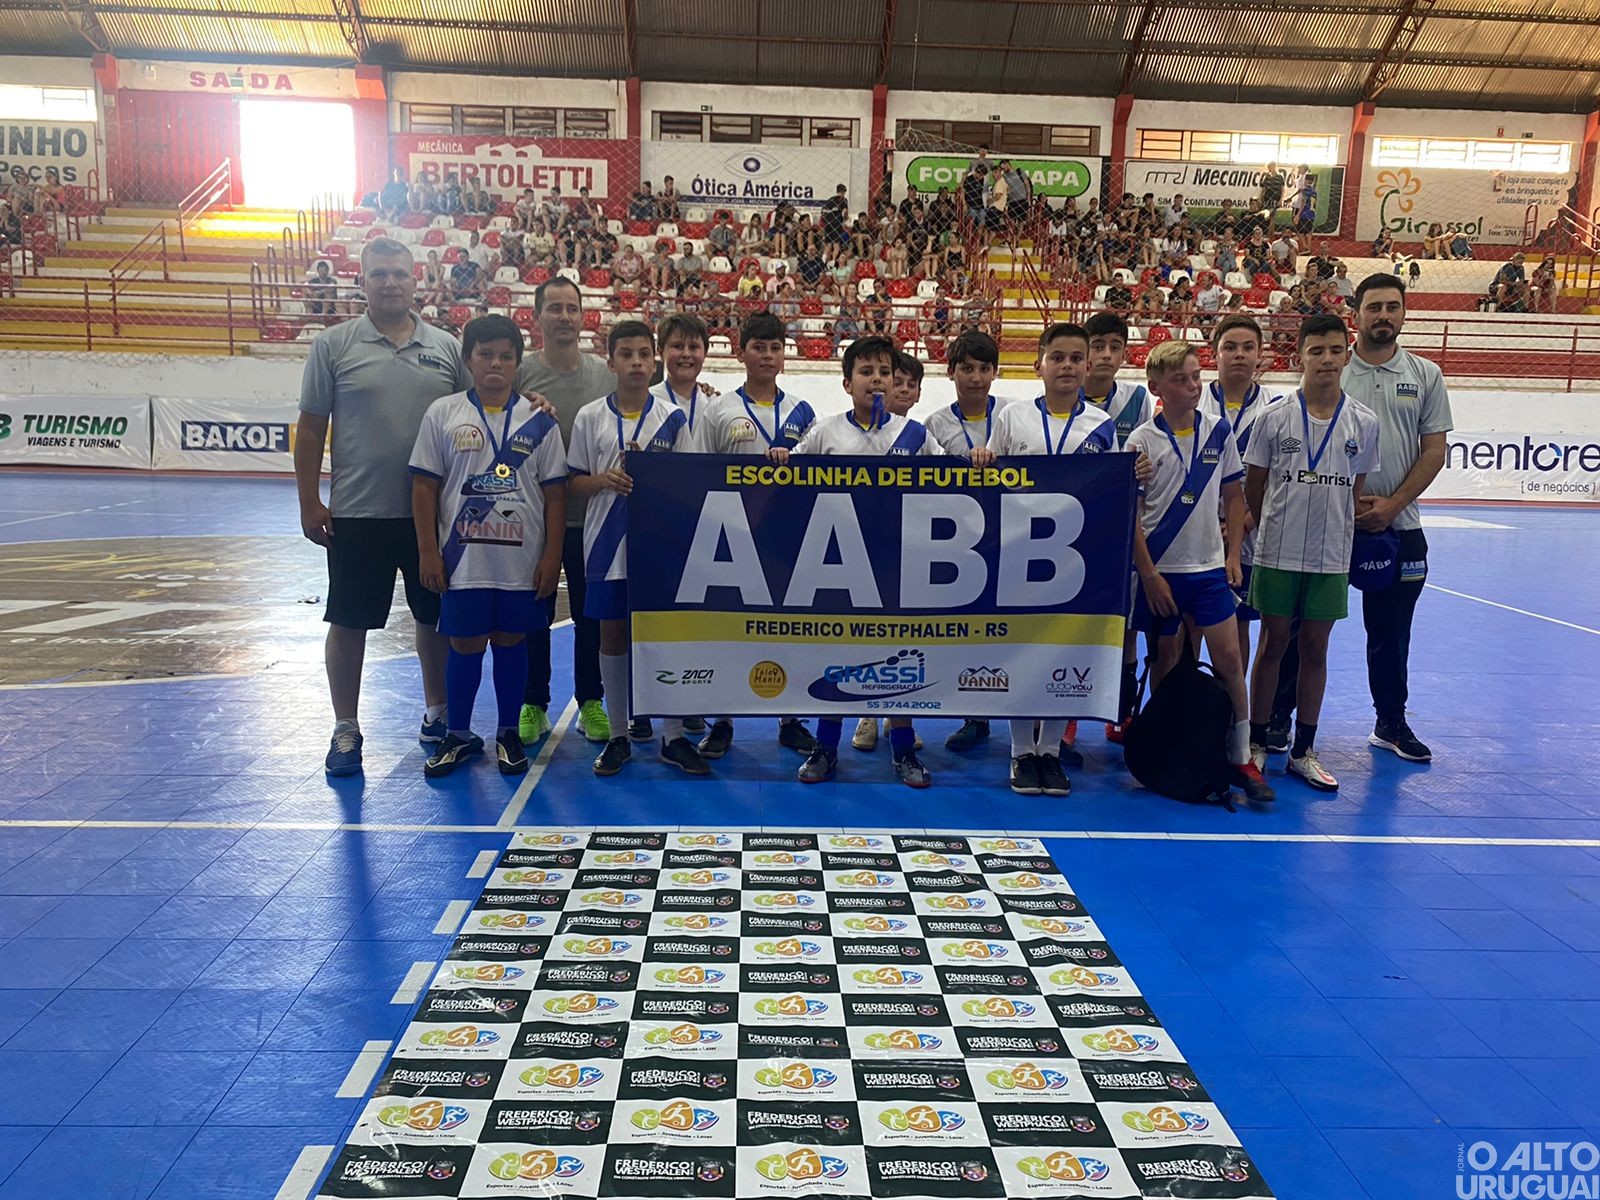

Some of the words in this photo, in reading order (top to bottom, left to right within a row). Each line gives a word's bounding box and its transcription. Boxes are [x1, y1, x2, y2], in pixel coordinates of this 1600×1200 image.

[418, 140, 463, 153] MECÂNICA
[422, 161, 593, 191] BERTOLETTI
[1024, 169, 1080, 187] APA
[692, 174, 737, 196] Ótica
[743, 180, 813, 198] América
[1537, 178, 1568, 186] completa
[1517, 188, 1553, 196] brinquedos
[1497, 197, 1526, 205] utilidades
[23, 414, 128, 436] TURISMO
[186, 424, 284, 449] BAKOF
[27, 436, 67, 447] VIAGENS
[70, 438, 75, 447] E
[78, 438, 121, 449] TURISMO
[726, 465, 872, 487] ESCOLINHA
[879, 467, 913, 486] DE
[919, 467, 1034, 488] FUTEBOL
[456, 520, 524, 539] VANIN
[674, 490, 1087, 608] AABB
[745, 619, 844, 638] FREDERICO
[849, 621, 969, 639] WESTPHALEN
[985, 621, 1009, 638] RS
[824, 665, 925, 683] GRASSI
[958, 675, 1009, 687] VANIN
[861, 683, 924, 691] REFRIGERAÇÃO
[867, 701, 880, 709] 55
[883, 701, 942, 710] 3744.2002
[527, 1031, 589, 1040] FREDERICO
[748, 1033, 808, 1041] FREDERICO
[525, 1037, 590, 1046] WESTPHALEN
[967, 1036, 1027, 1045] FREDERICO
[970, 1042, 1032, 1051] WESTPHALEN
[393, 1069, 463, 1077] FREDERICO
[630, 1069, 697, 1078] FREDERICO
[864, 1073, 929, 1081] FREDERICO
[1093, 1071, 1159, 1081] FREDERICO
[390, 1075, 461, 1084] WESTPHALEN
[631, 1075, 697, 1085] WESTPHALEN
[1097, 1078, 1161, 1087] WESTPHALEN
[499, 1110, 569, 1119] FREDERICO
[748, 1111, 816, 1120] FREDERICO
[992, 1114, 1062, 1123] FREDERICO
[497, 1116, 569, 1126] WESTPHALEN
[749, 1117, 818, 1126] WESTPHALEN
[996, 1120, 1066, 1129] WESTPHALEN
[345, 1160, 425, 1169] FREDERICO
[615, 1159, 690, 1169] FREDERICO
[878, 1160, 952, 1170] FREDERICO
[1137, 1159, 1210, 1171] FREDERICO
[344, 1166, 422, 1177] WESTPHALEN
[615, 1167, 690, 1176] WESTPHALEN
[880, 1167, 954, 1177] WESTPHALEN
[1141, 1167, 1216, 1178] WESTPHALEN
